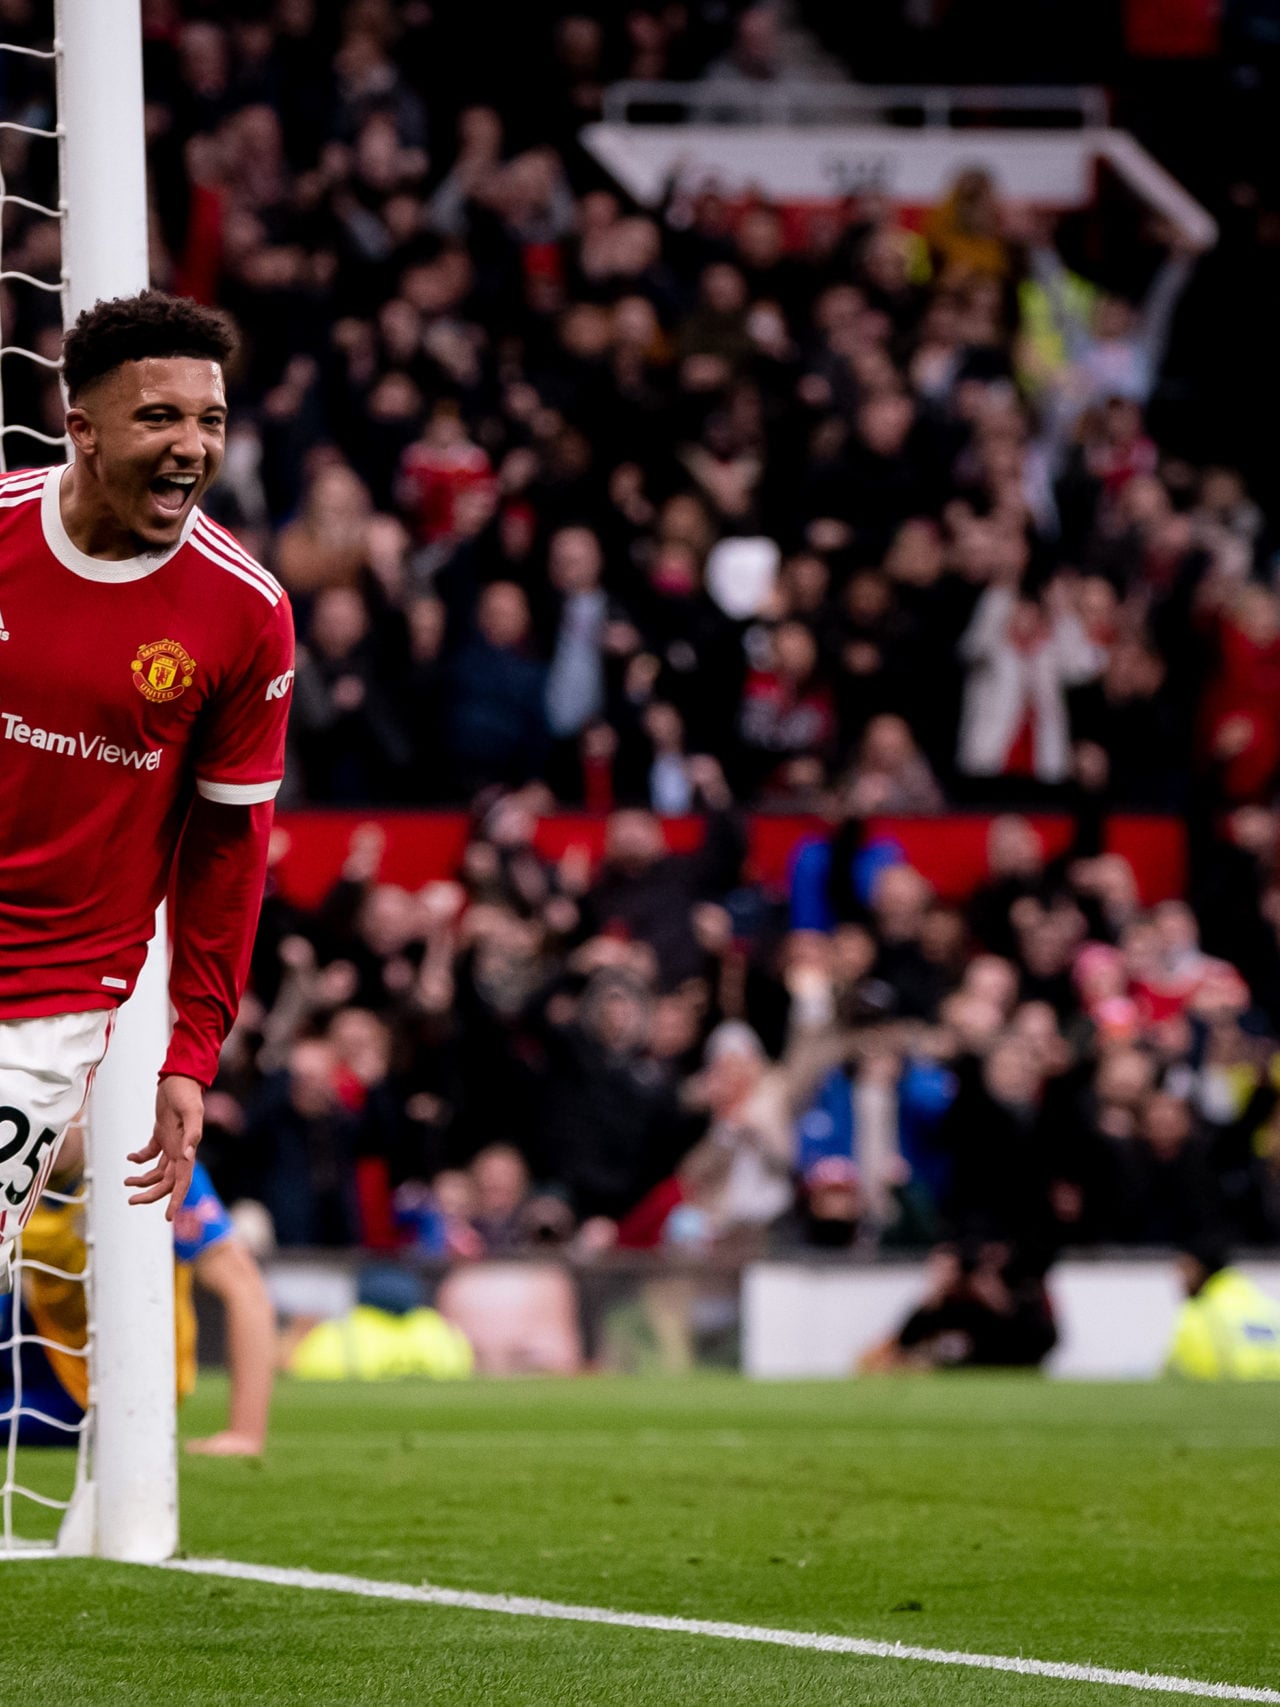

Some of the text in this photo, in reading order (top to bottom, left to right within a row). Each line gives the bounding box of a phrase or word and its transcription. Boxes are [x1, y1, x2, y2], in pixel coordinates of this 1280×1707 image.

[141, 643, 191, 672] MANCHESTER
[140, 683, 173, 699] UNITED
[265, 669, 294, 700] KO
[1, 712, 163, 771] TeamViewer
